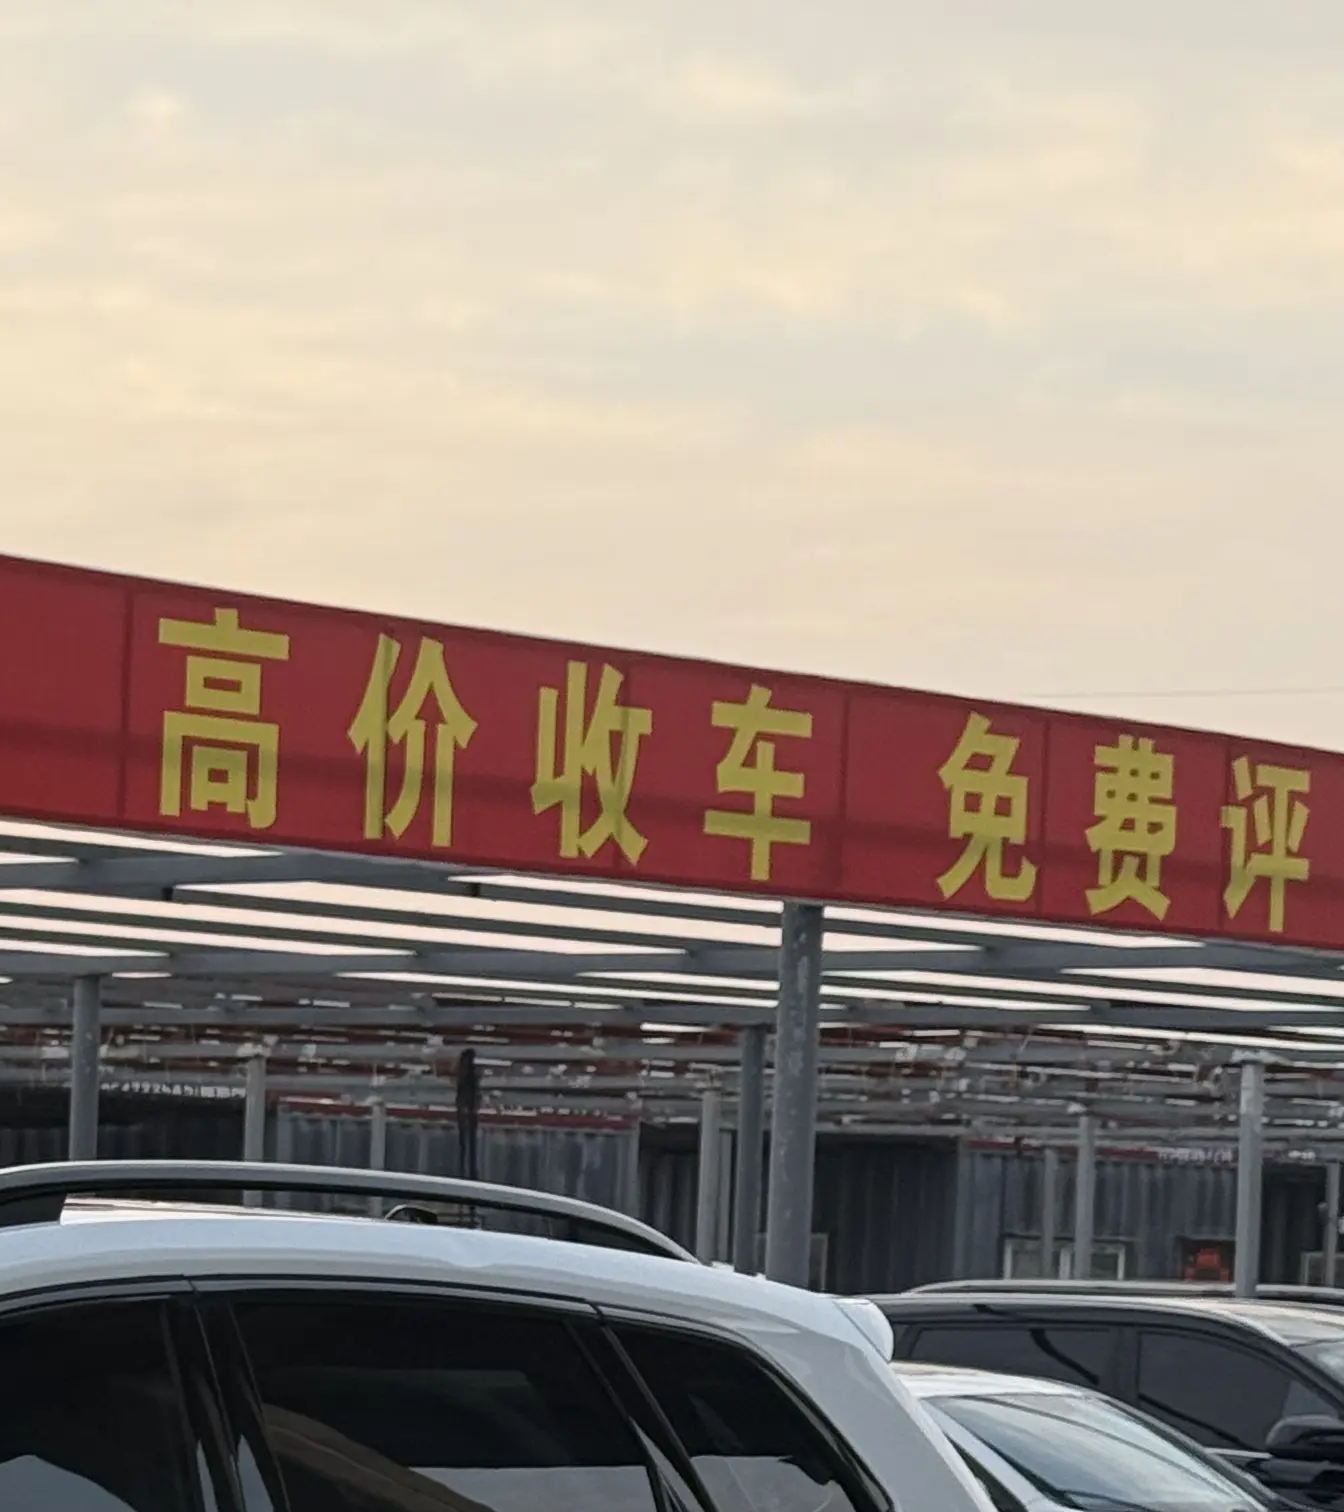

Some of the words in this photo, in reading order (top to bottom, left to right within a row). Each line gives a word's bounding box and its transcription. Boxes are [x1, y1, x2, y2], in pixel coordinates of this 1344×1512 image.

[158, 608, 813, 881] 高价收车
[938, 713, 1311, 932] 免费评
